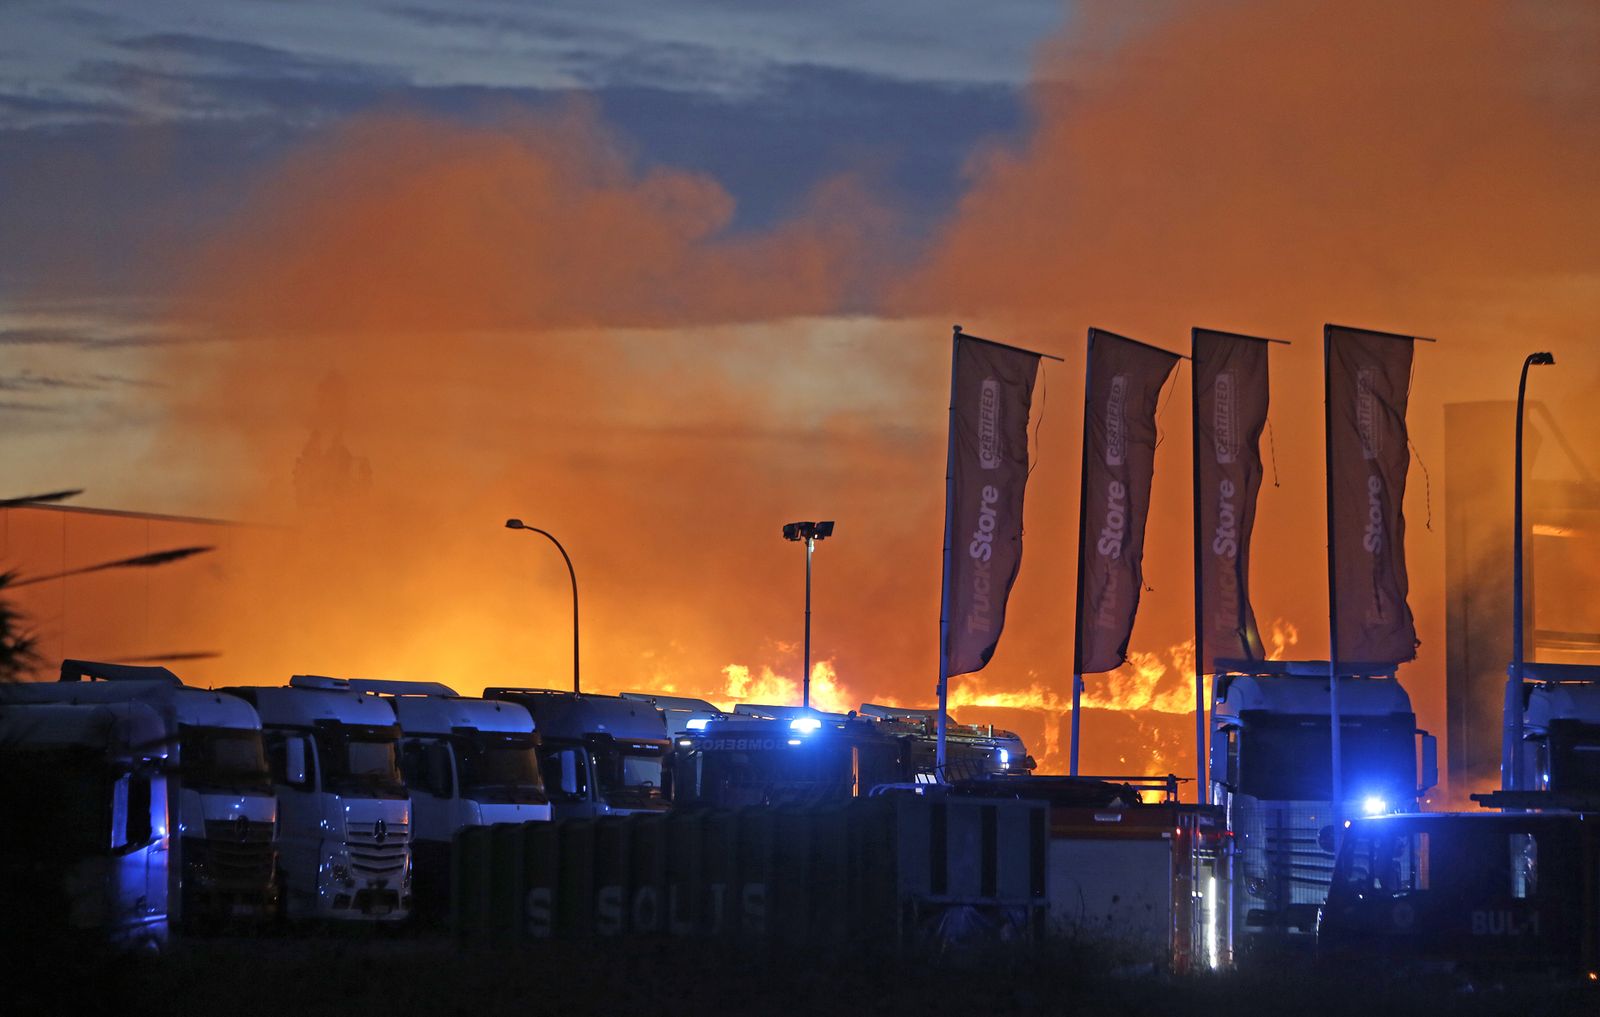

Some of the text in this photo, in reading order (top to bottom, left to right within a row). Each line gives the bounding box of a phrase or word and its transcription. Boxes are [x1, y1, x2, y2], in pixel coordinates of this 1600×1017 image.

[981, 387, 995, 462] CERTIFIED
[1108, 383, 1122, 458] CERTIFIED
[1216, 380, 1229, 456] CERTIFIED
[1472, 910, 1540, 935] BUL-1
